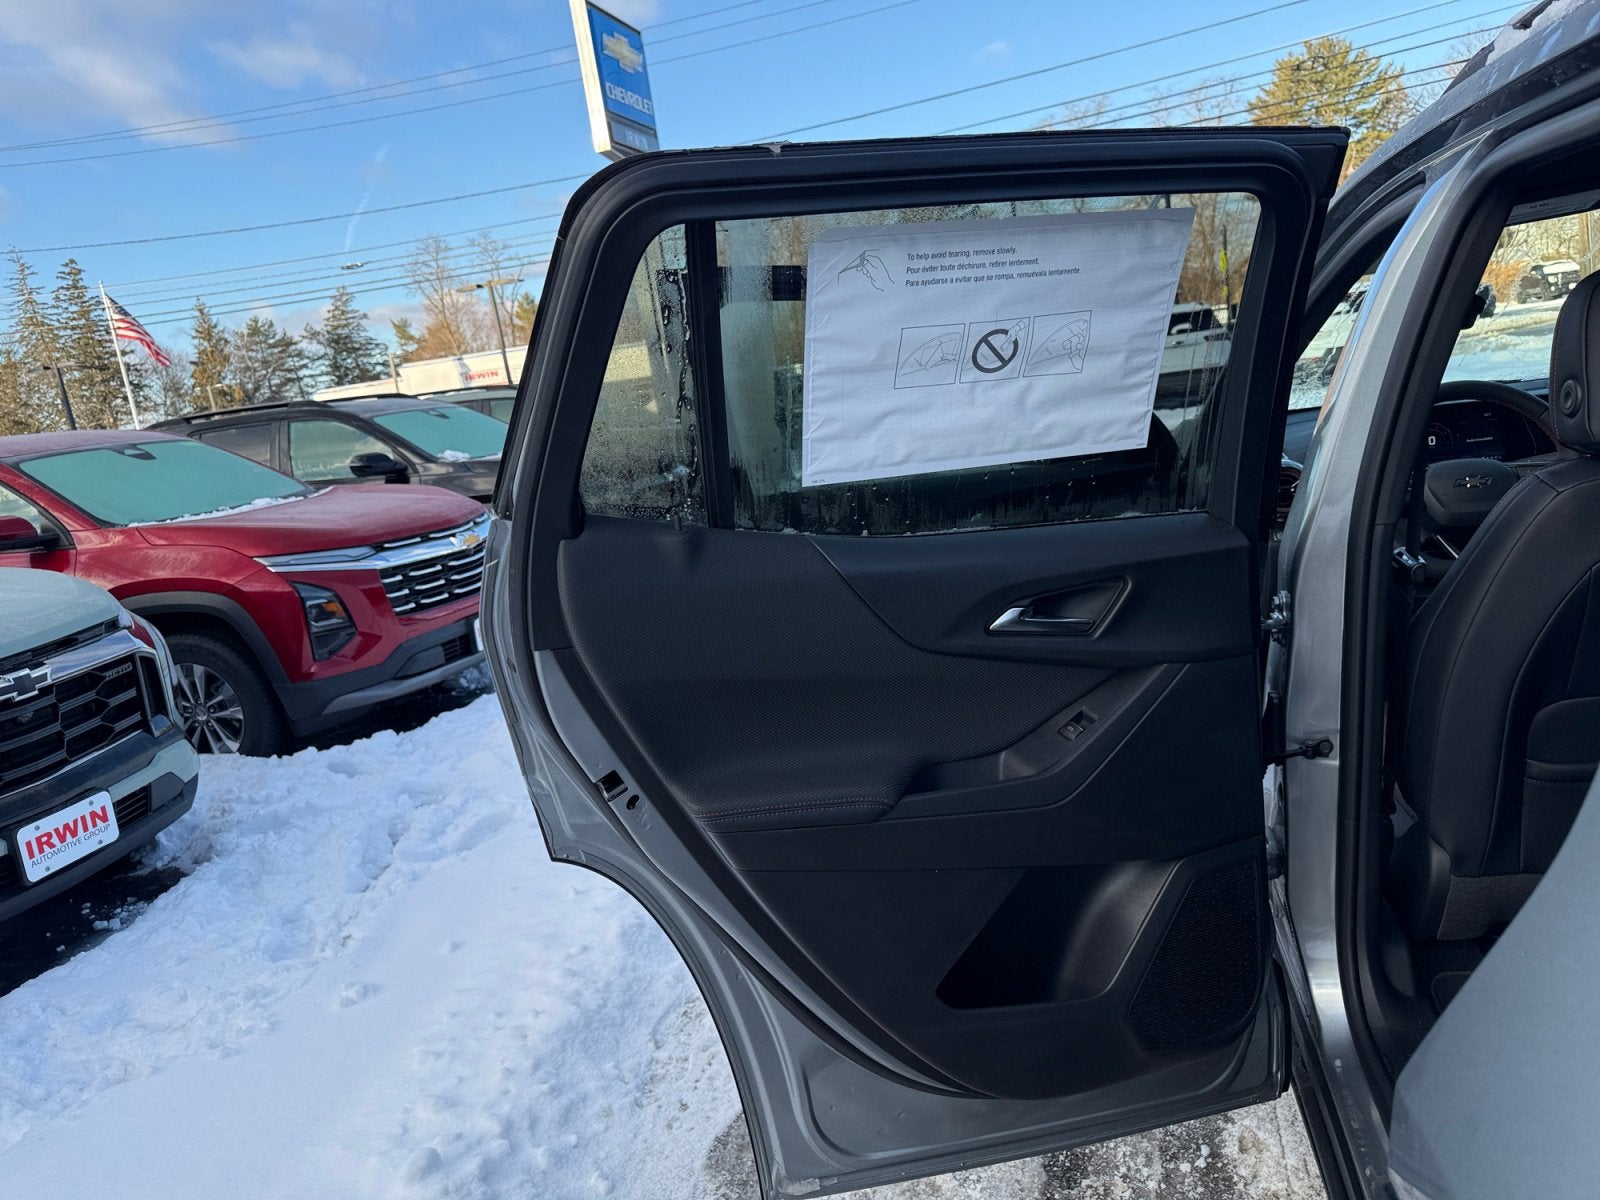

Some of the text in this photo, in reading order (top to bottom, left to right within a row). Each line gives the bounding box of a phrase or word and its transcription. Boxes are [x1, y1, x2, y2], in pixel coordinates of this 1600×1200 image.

[605, 82, 653, 114] CHEVROLET
[916, 252, 929, 261] help
[930, 250, 947, 259] avoid
[948, 250, 971, 258] tearing,
[972, 248, 995, 256] remove
[997, 246, 1017, 255] slowly.
[906, 266, 920, 274] Pour
[922, 265, 938, 273] éviter
[957, 262, 987, 270] déchirure,
[988, 260, 1007, 268] retirer
[1009, 258, 1040, 266] lentement.
[905, 279, 919, 287] Para
[974, 275, 984, 283] que
[464, 370, 499, 381] IRWIN
[1428, 436, 1436, 446] 0
[25, 804, 109, 861] IRWIN
[31, 824, 112, 868] AUTOMOTIVE GROUP
